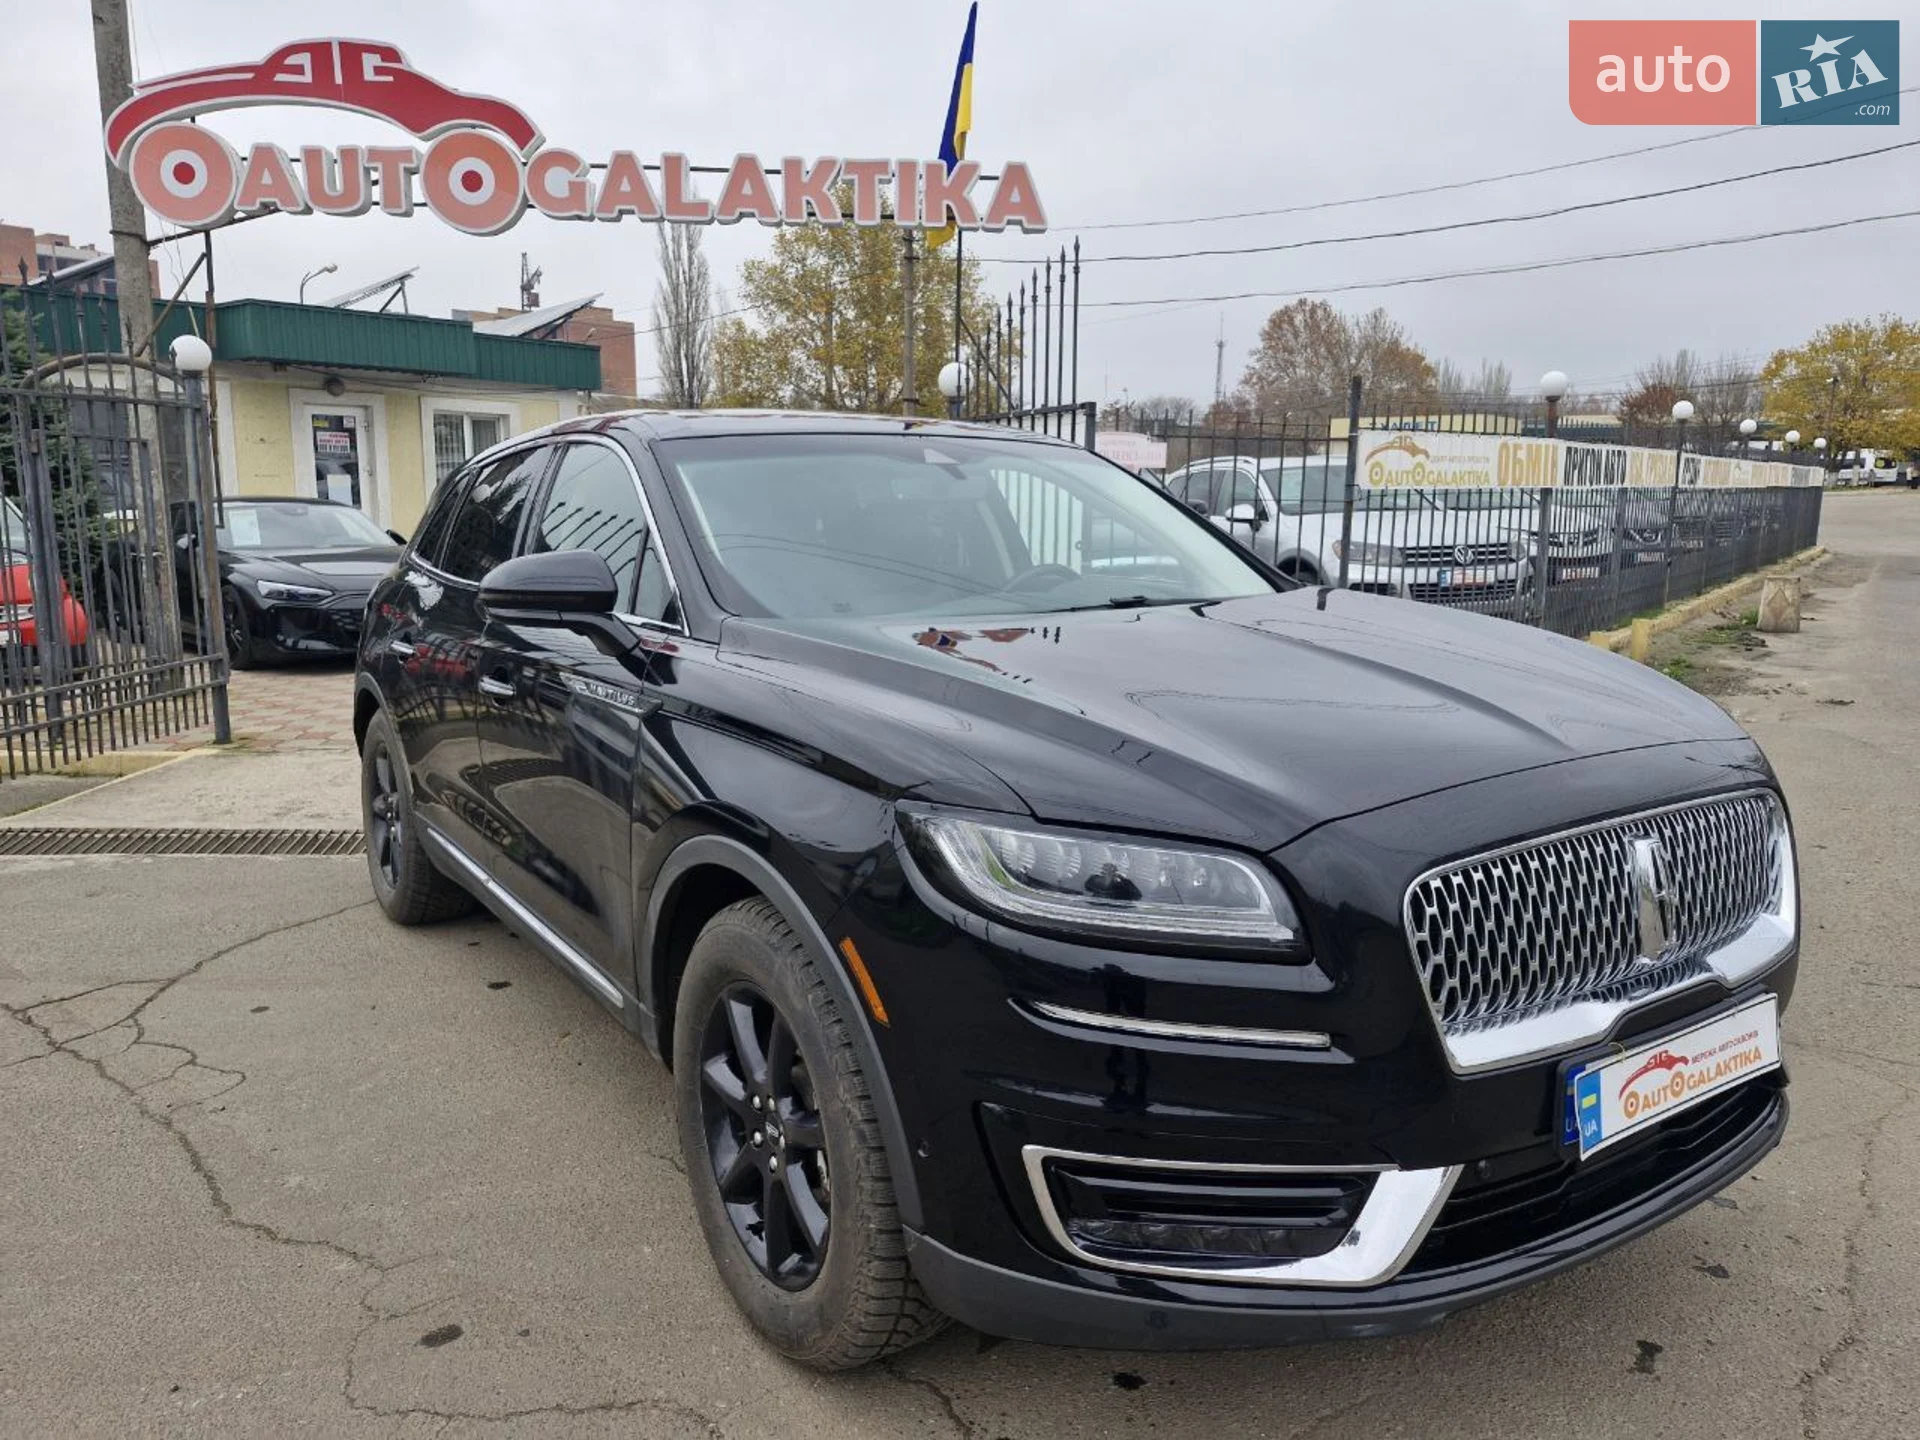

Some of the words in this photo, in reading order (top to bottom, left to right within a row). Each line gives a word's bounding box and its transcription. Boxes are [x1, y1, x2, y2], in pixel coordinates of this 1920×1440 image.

[1498, 440, 1558, 487] ОБМІН
[1564, 446, 1602, 486] ПРИГОН
[1603, 449, 1627, 486] АВТО
[1583, 1119, 1598, 1138] UA
